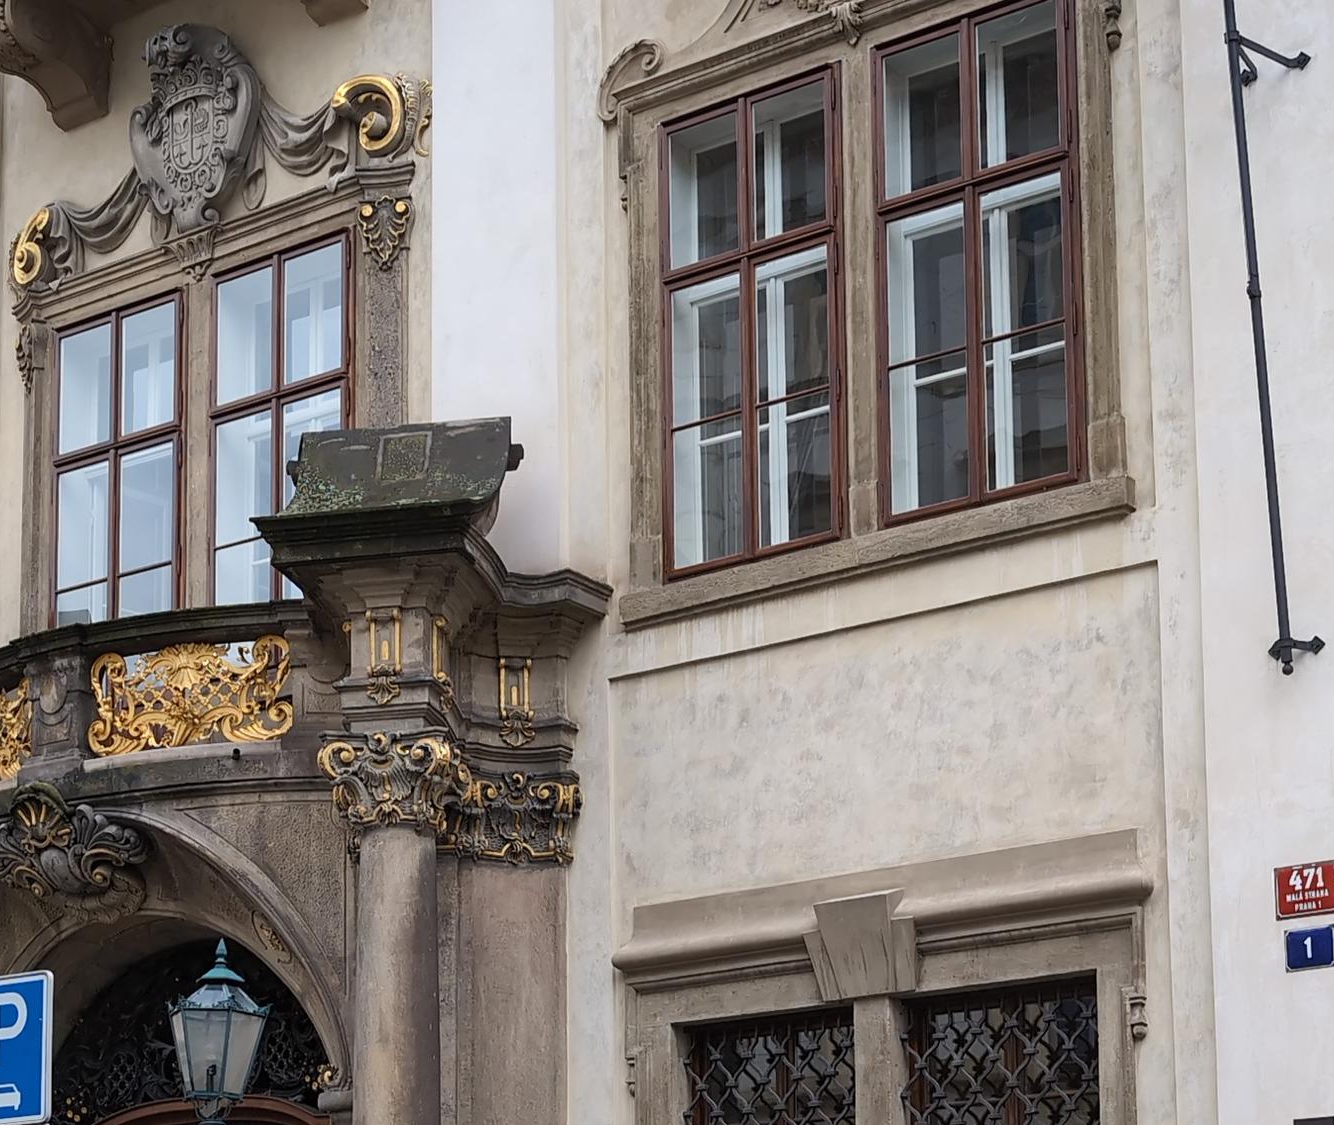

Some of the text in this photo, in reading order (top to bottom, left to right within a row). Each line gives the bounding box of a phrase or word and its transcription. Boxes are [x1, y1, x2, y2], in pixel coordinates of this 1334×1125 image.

[1289, 866, 1325, 891] 471
[1286, 888, 1329, 903] MALÁ STRANA
[1294, 900, 1322, 912] PRAHA 1
[1303, 936, 1313, 959] 1
